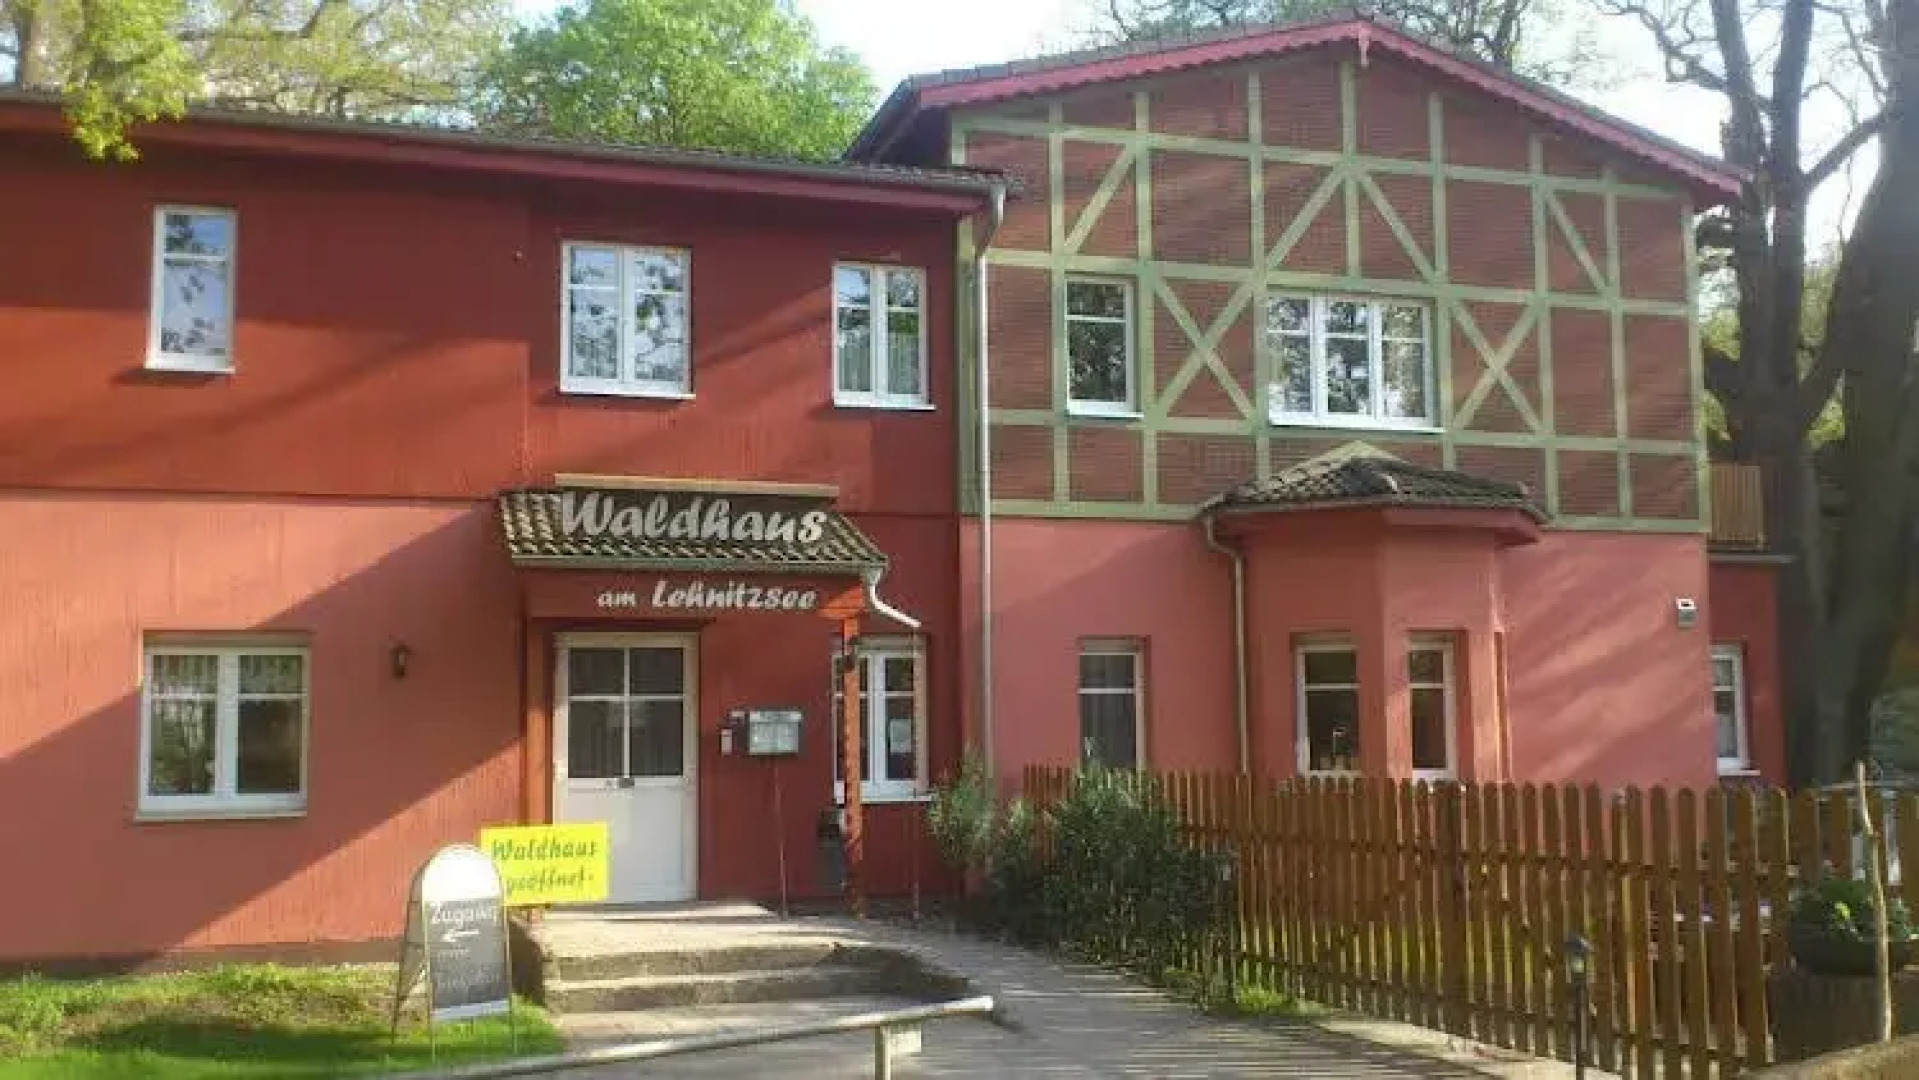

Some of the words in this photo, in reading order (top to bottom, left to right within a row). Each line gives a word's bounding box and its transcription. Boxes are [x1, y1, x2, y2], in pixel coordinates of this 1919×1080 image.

[561, 491, 828, 544] Waldhaus
[597, 591, 636, 609] am
[652, 580, 817, 609] Lehnitzsee
[492, 837, 599, 861] Waldhaus
